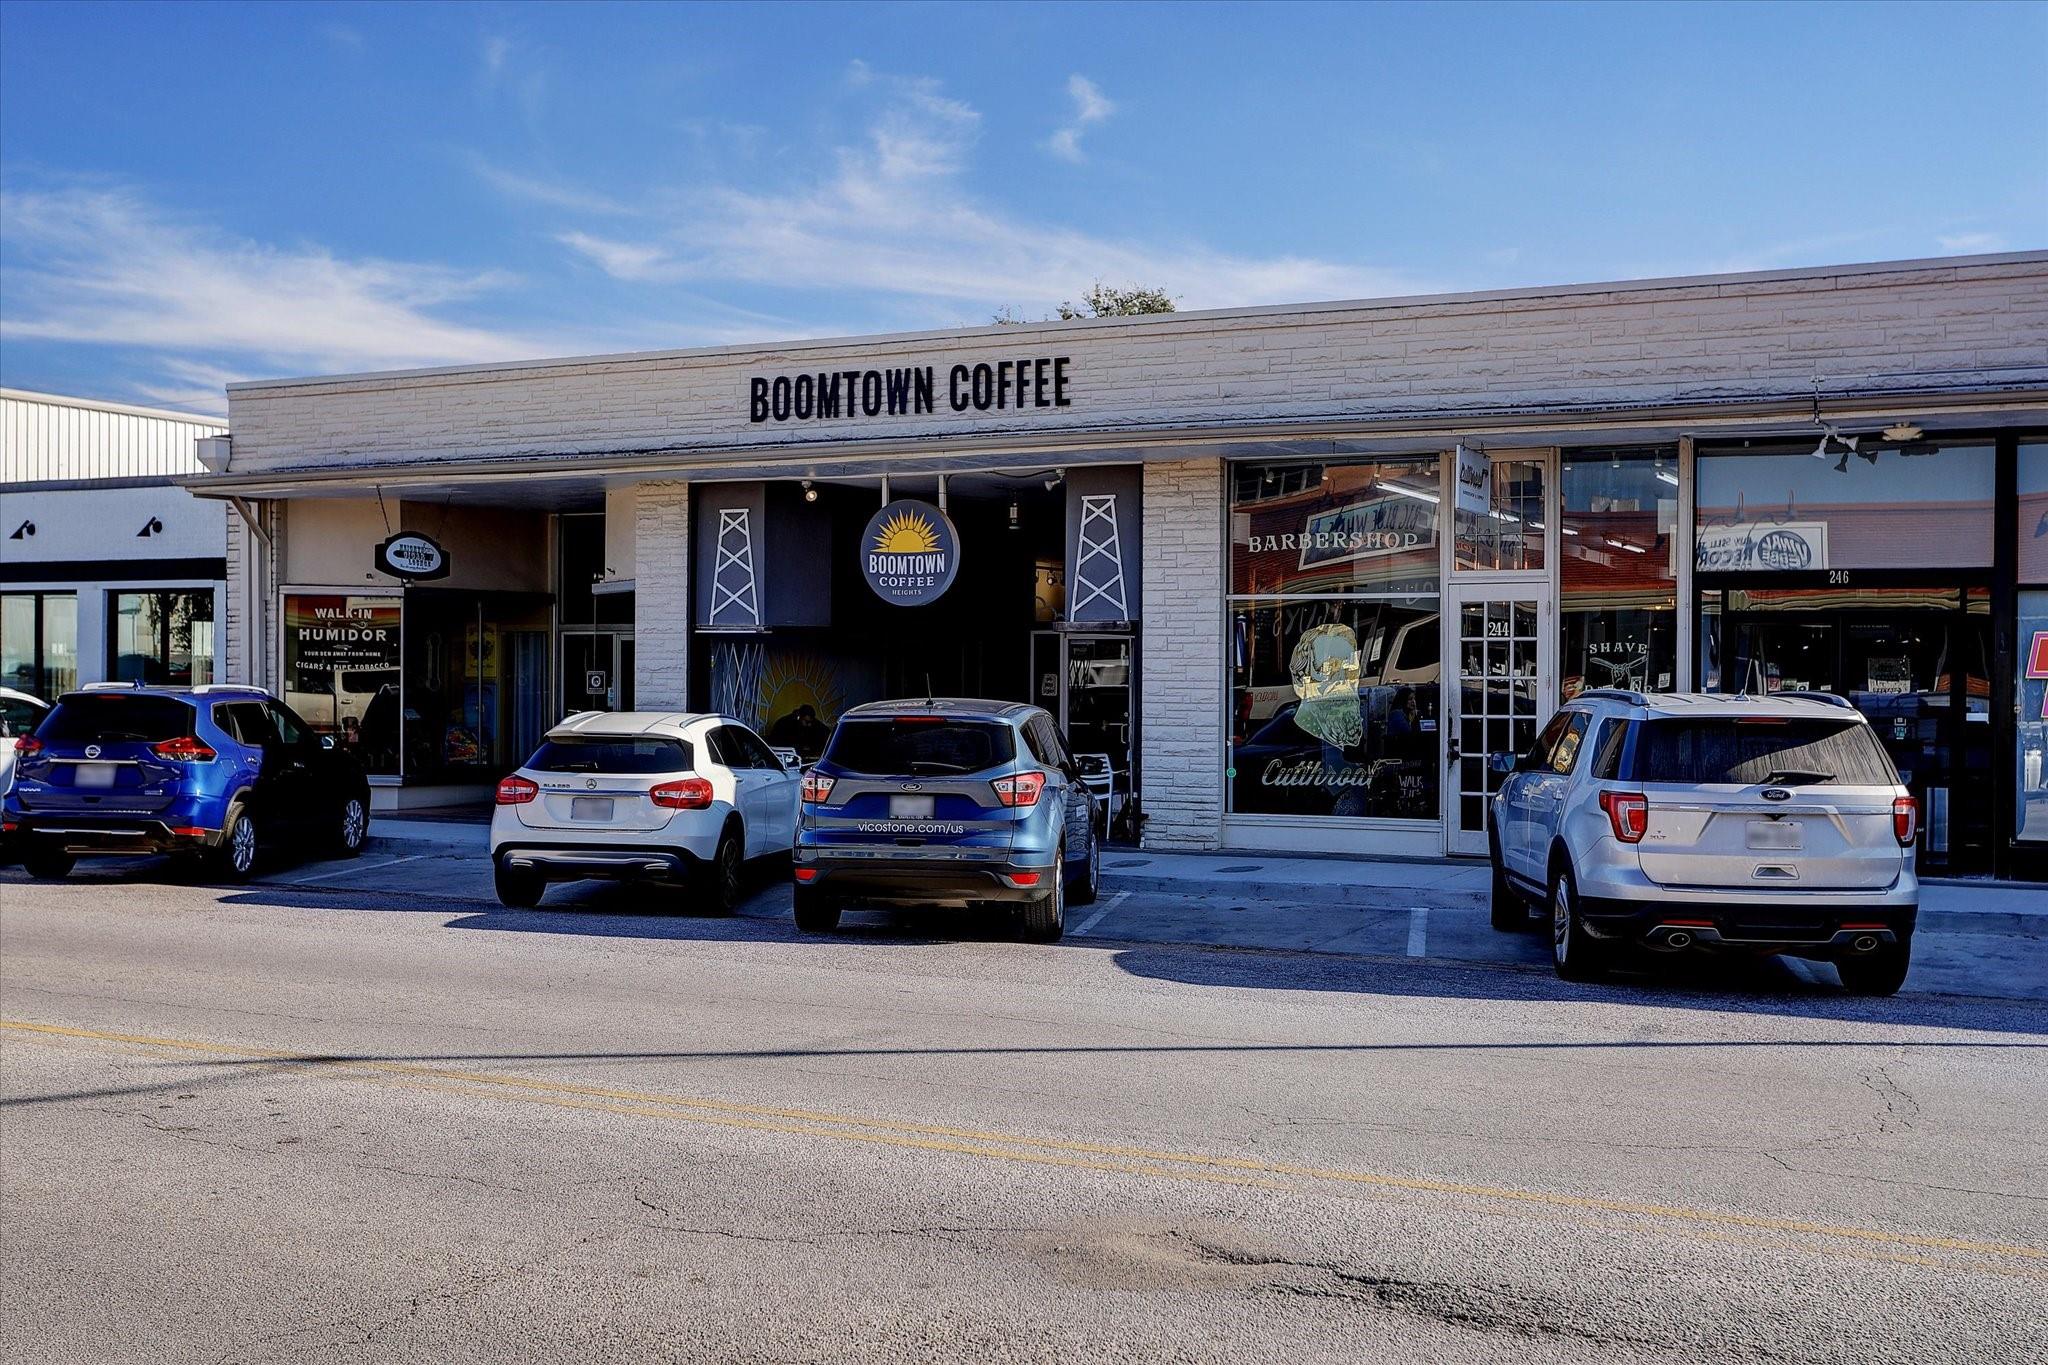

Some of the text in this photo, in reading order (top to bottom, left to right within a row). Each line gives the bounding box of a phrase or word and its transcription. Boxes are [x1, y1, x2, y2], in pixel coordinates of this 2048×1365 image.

[750, 357, 1071, 423] BOOMTOWN COFFEE
[1248, 532, 1419, 553] BARBERSHOP
[869, 553, 945, 575] BOOMTOWN
[879, 576, 935, 587] COFFEE
[1829, 570, 1849, 584] 246
[298, 628, 388, 642] HUMIDOR
[1488, 621, 1510, 636] 244
[1589, 642, 1648, 654] SHAVE
[295, 661, 324, 671] CIGARS
[355, 662, 390, 671] TOBACCO
[857, 821, 964, 834] vicostone.com/us
